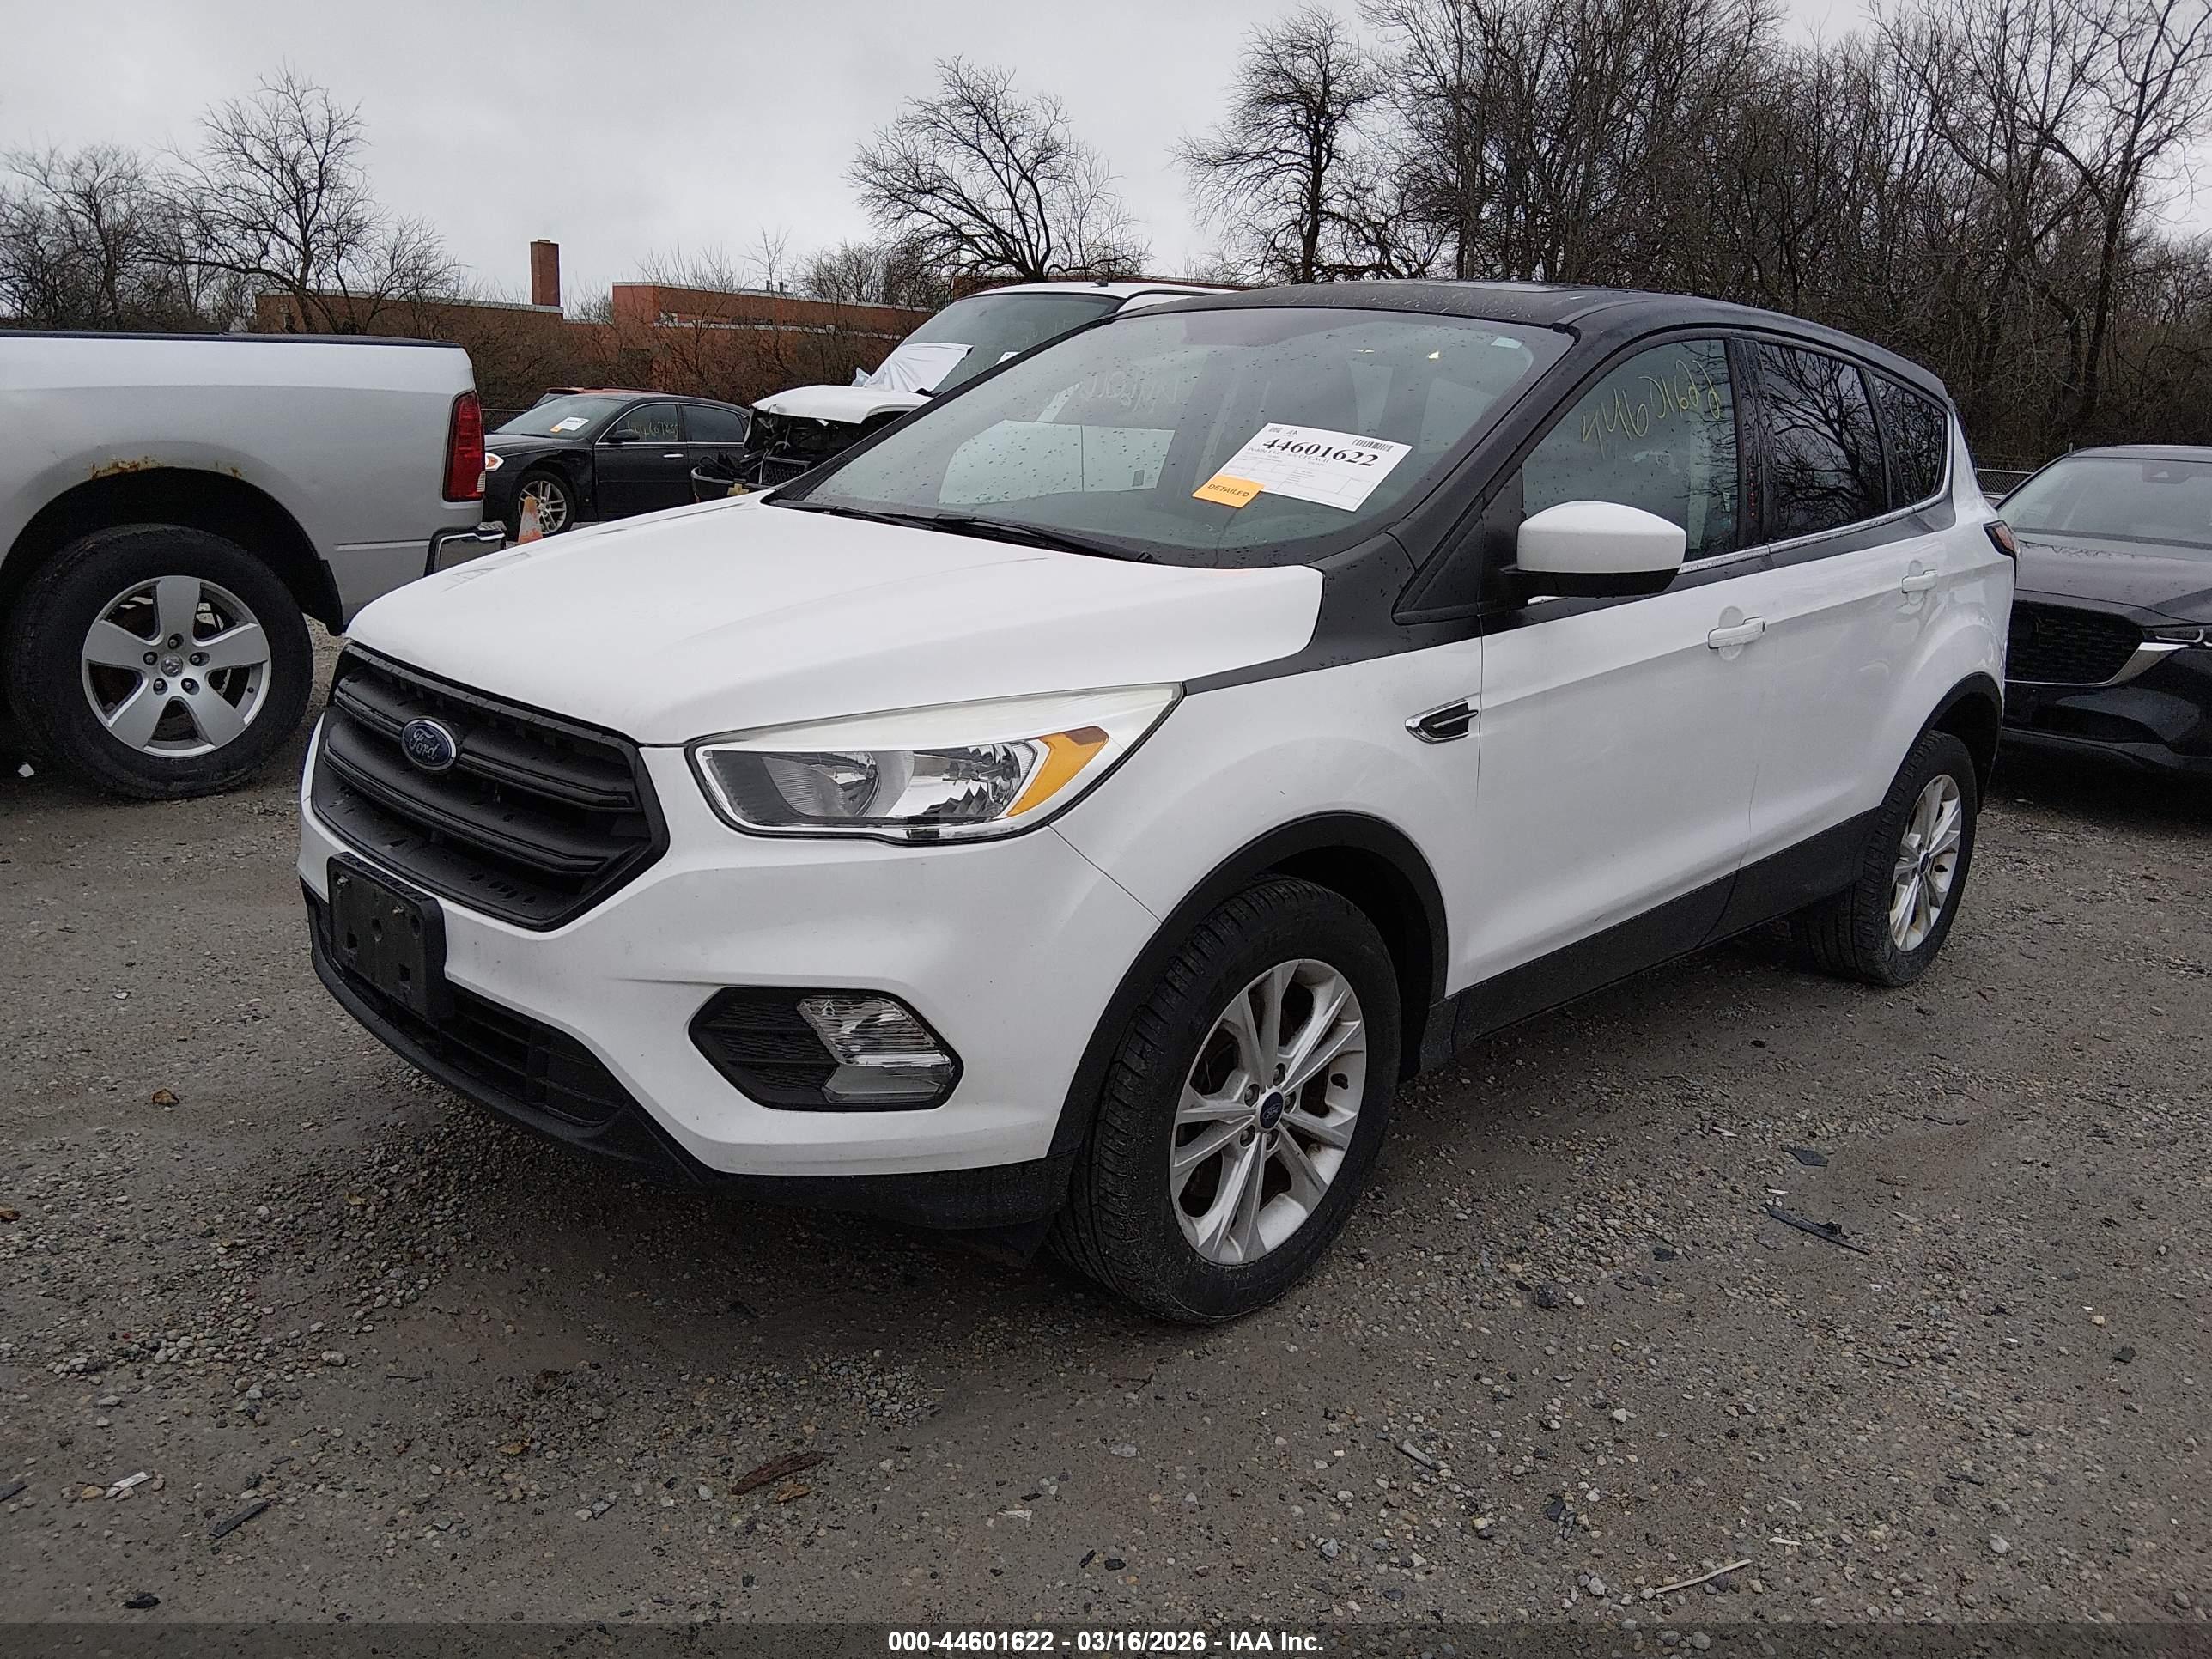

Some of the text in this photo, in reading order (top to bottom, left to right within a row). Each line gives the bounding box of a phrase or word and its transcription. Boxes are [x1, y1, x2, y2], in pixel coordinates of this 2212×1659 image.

[1262, 437, 1380, 468] 44601622
[1207, 483, 1250, 498] DETAILED
[409, 728, 441, 761] Ford
